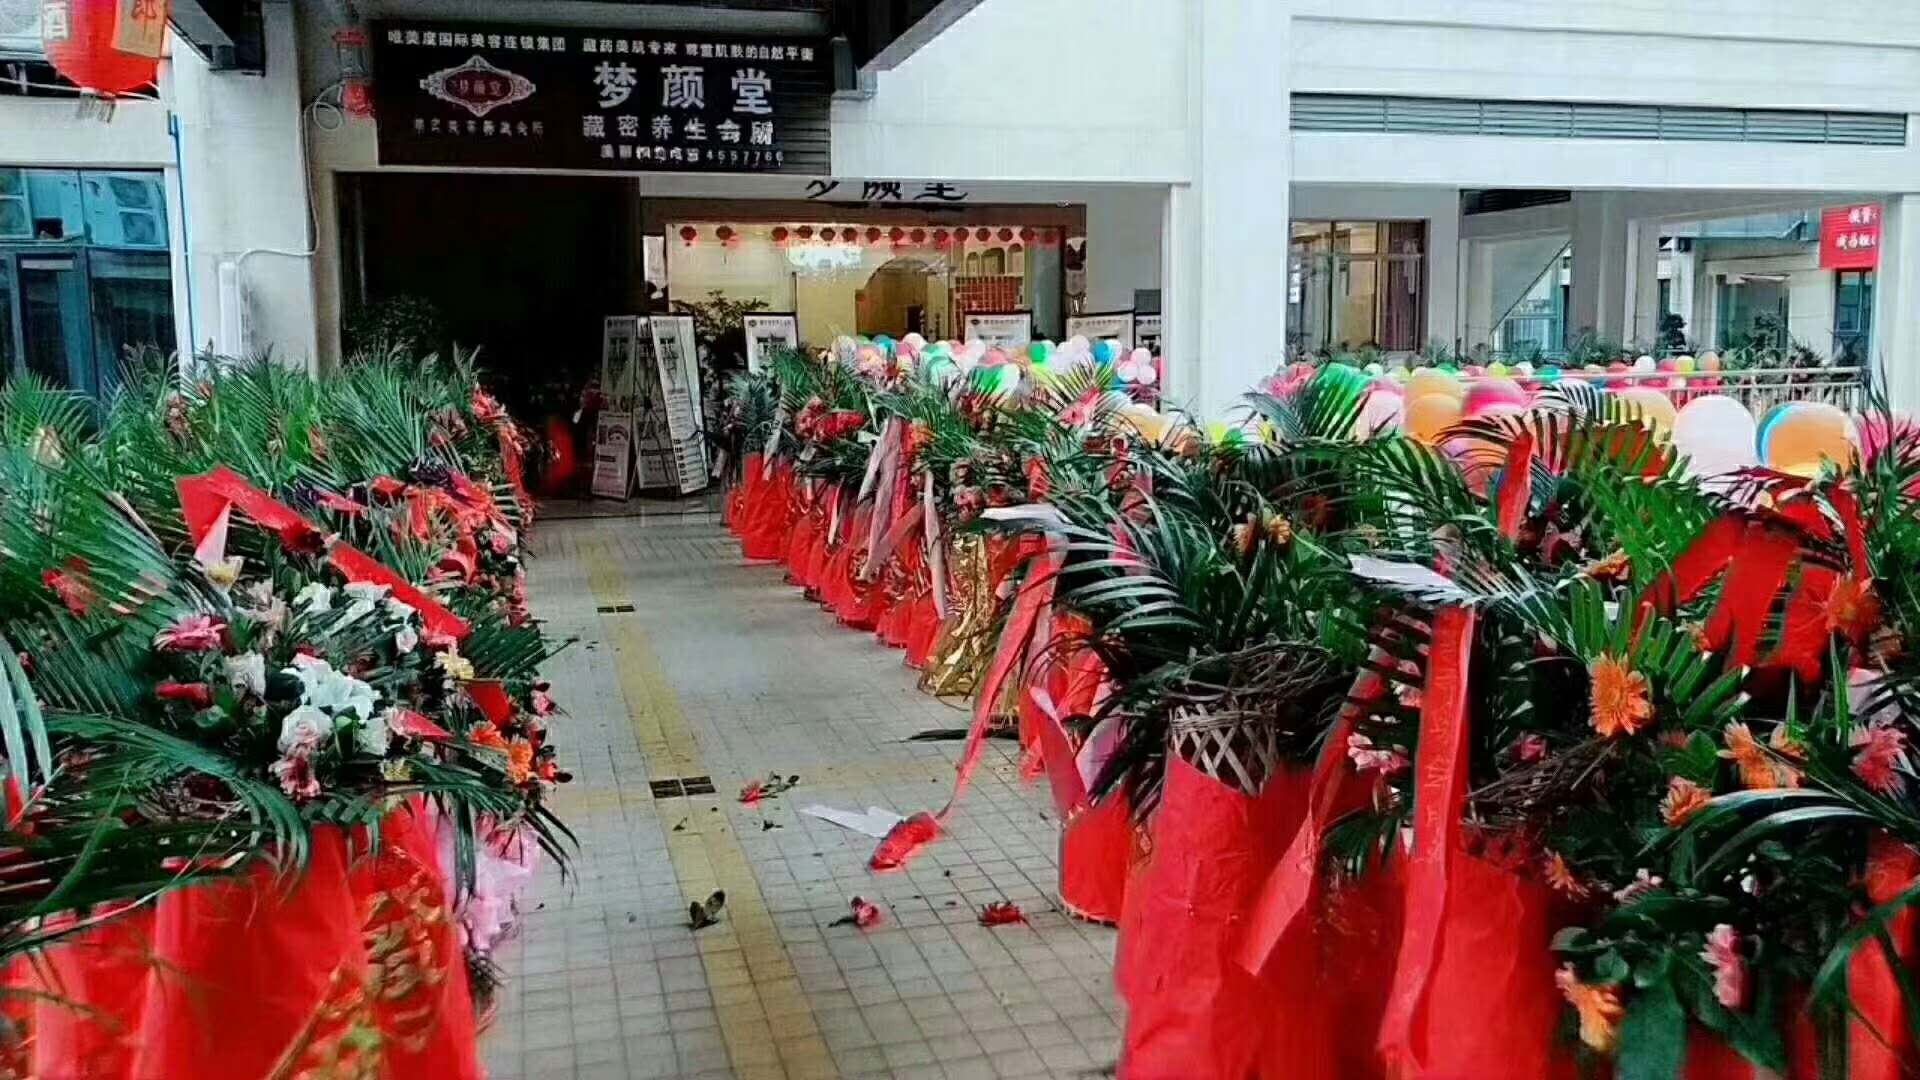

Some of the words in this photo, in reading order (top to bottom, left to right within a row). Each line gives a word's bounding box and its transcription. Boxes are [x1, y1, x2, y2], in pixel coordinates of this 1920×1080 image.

[593, 60, 774, 115] 梦颜堂
[582, 115, 775, 145] 藏密养生会所
